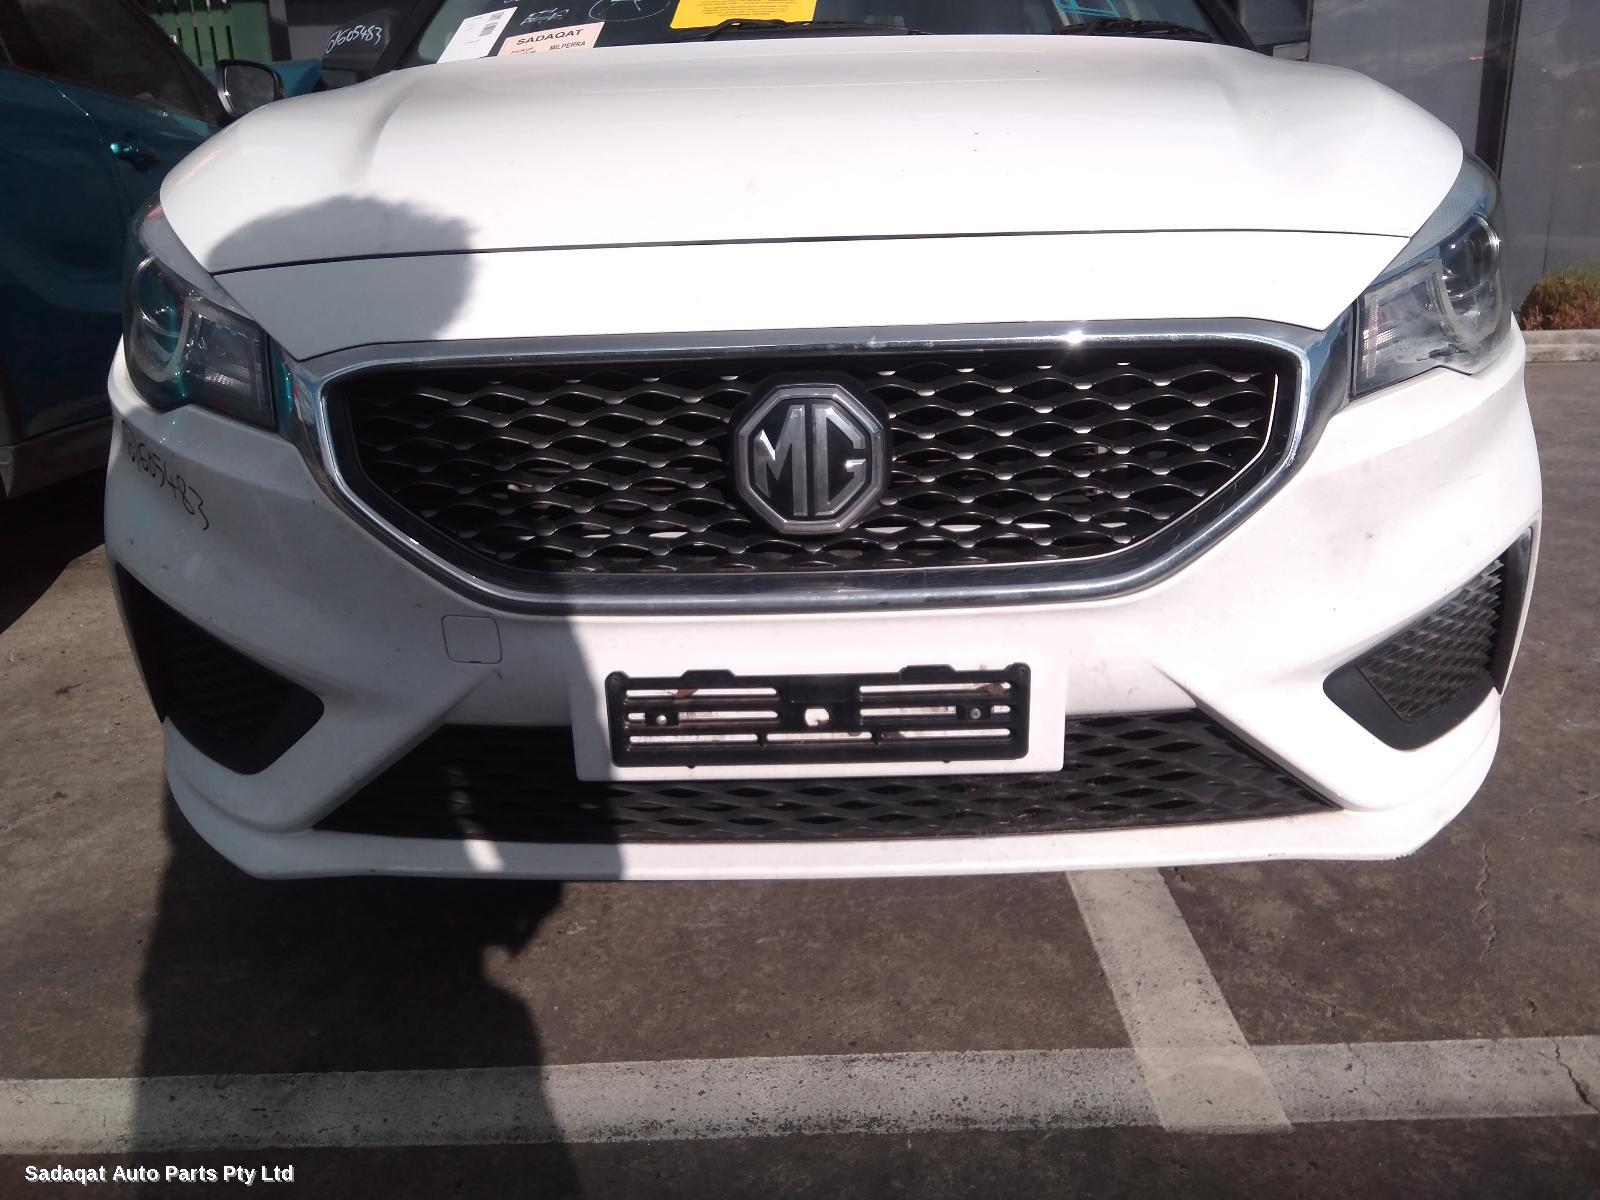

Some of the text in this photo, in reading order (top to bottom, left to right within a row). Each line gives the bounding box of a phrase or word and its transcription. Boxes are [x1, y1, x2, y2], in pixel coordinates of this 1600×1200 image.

[516, 28, 585, 46] SADAQAT
[549, 40, 587, 51] MILPERRA
[753, 404, 866, 517] MG
